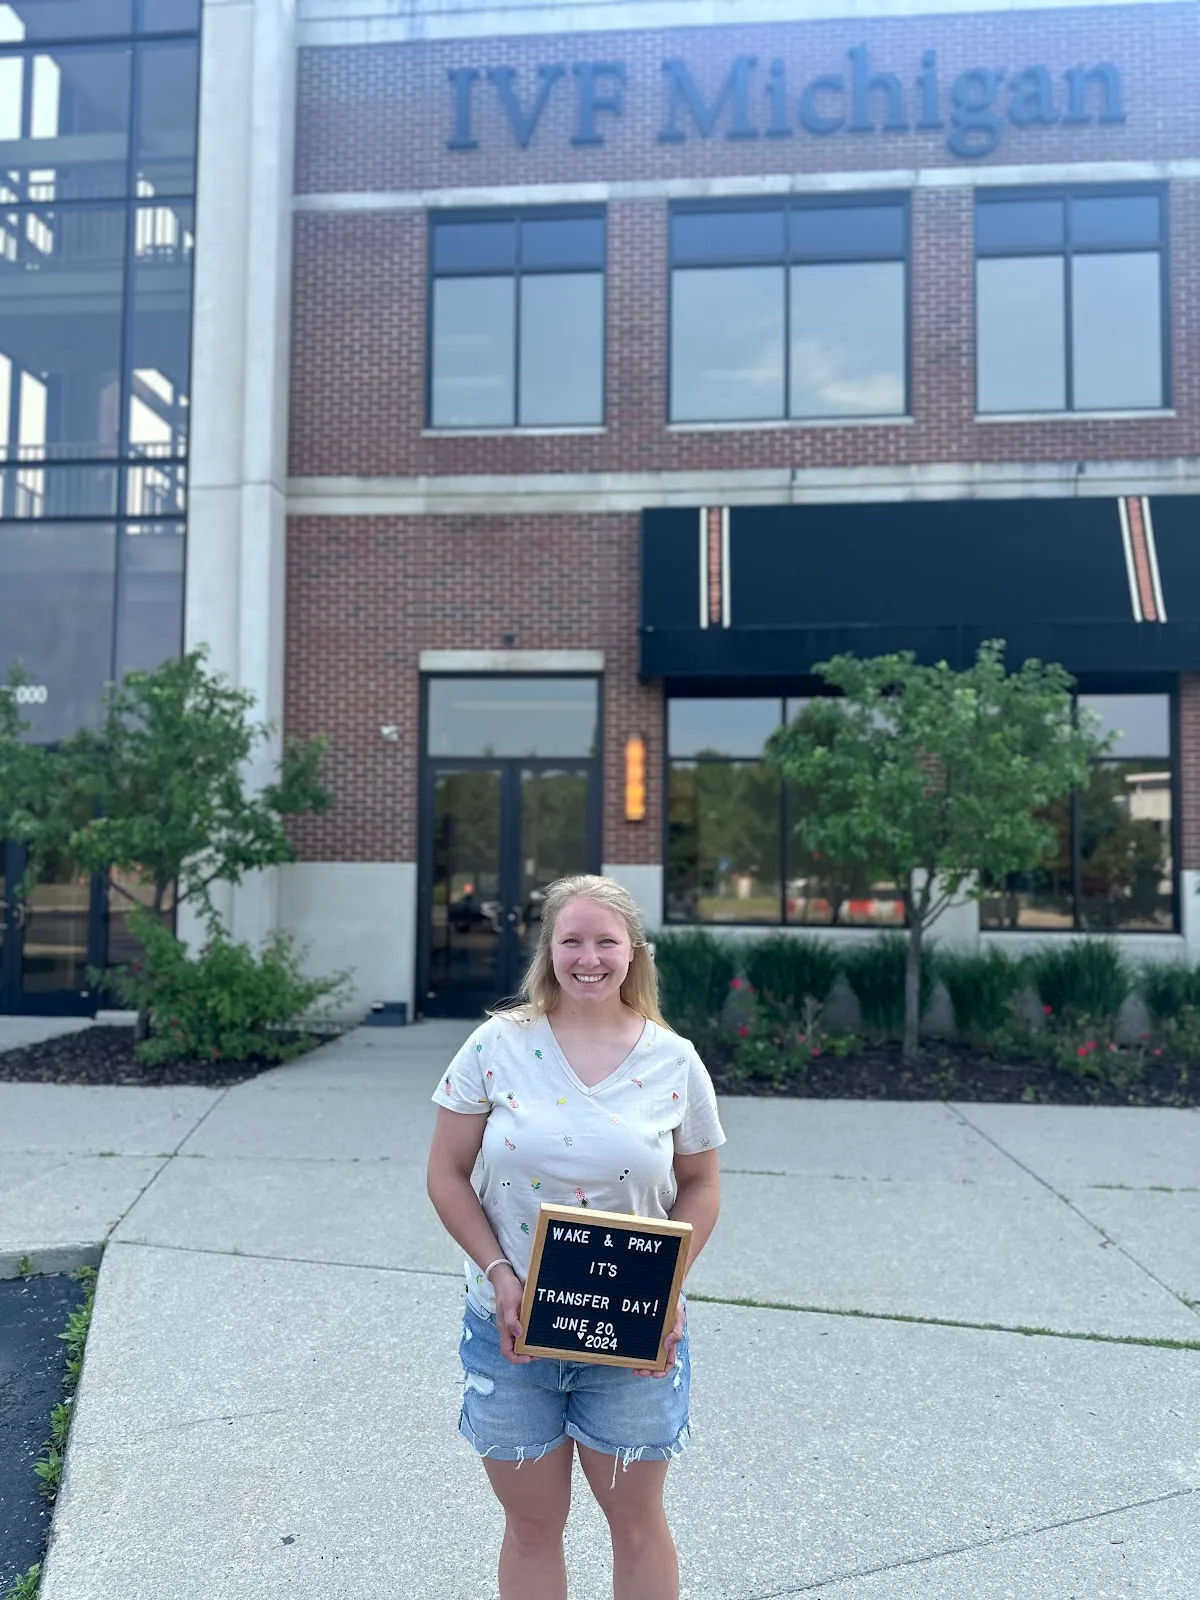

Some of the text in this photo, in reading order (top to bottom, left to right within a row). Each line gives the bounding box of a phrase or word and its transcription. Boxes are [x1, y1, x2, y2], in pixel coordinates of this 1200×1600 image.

[445, 43, 1127, 158] IVF Michigan
[8, 685, 48, 704] 000
[552, 1226, 662, 1254] WAKE & PRAY
[589, 1261, 618, 1277] IT'S
[537, 1288, 659, 1317] TRANSFER DAY!
[552, 1316, 590, 1333] JUNE
[584, 1334, 618, 1351] 2024
